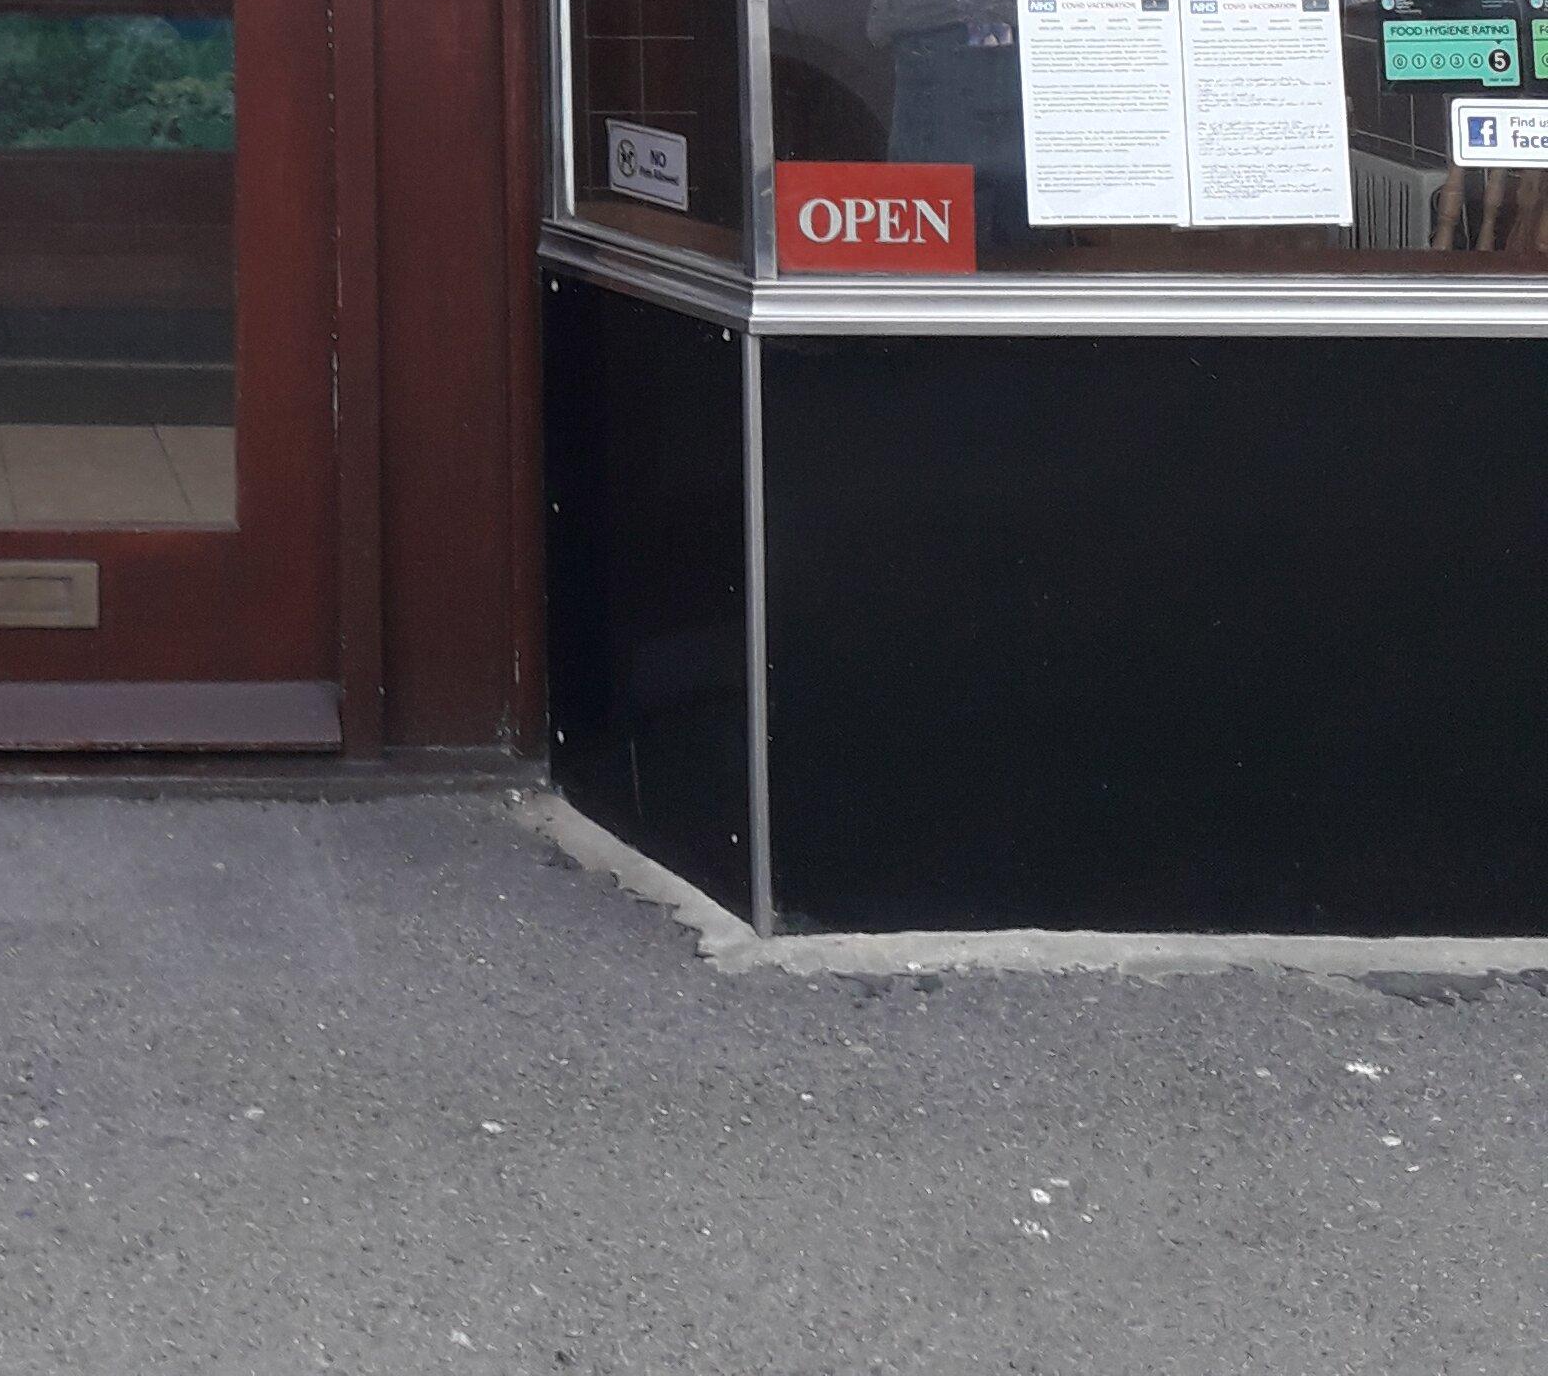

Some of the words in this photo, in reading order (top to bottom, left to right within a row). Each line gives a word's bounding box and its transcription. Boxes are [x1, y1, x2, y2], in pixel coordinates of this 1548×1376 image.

[1030, 1, 1055, 11] NHS
[1192, 1, 1216, 12] NHS
[1391, 26, 1422, 36] FOOD
[1425, 25, 1469, 36] HYGIENE
[1472, 25, 1510, 35] RATING
[1494, 52, 1506, 69] 5
[1510, 117, 1535, 127] Find
[1511, 129, 1548, 148] face
[798, 197, 952, 244] OPEN
